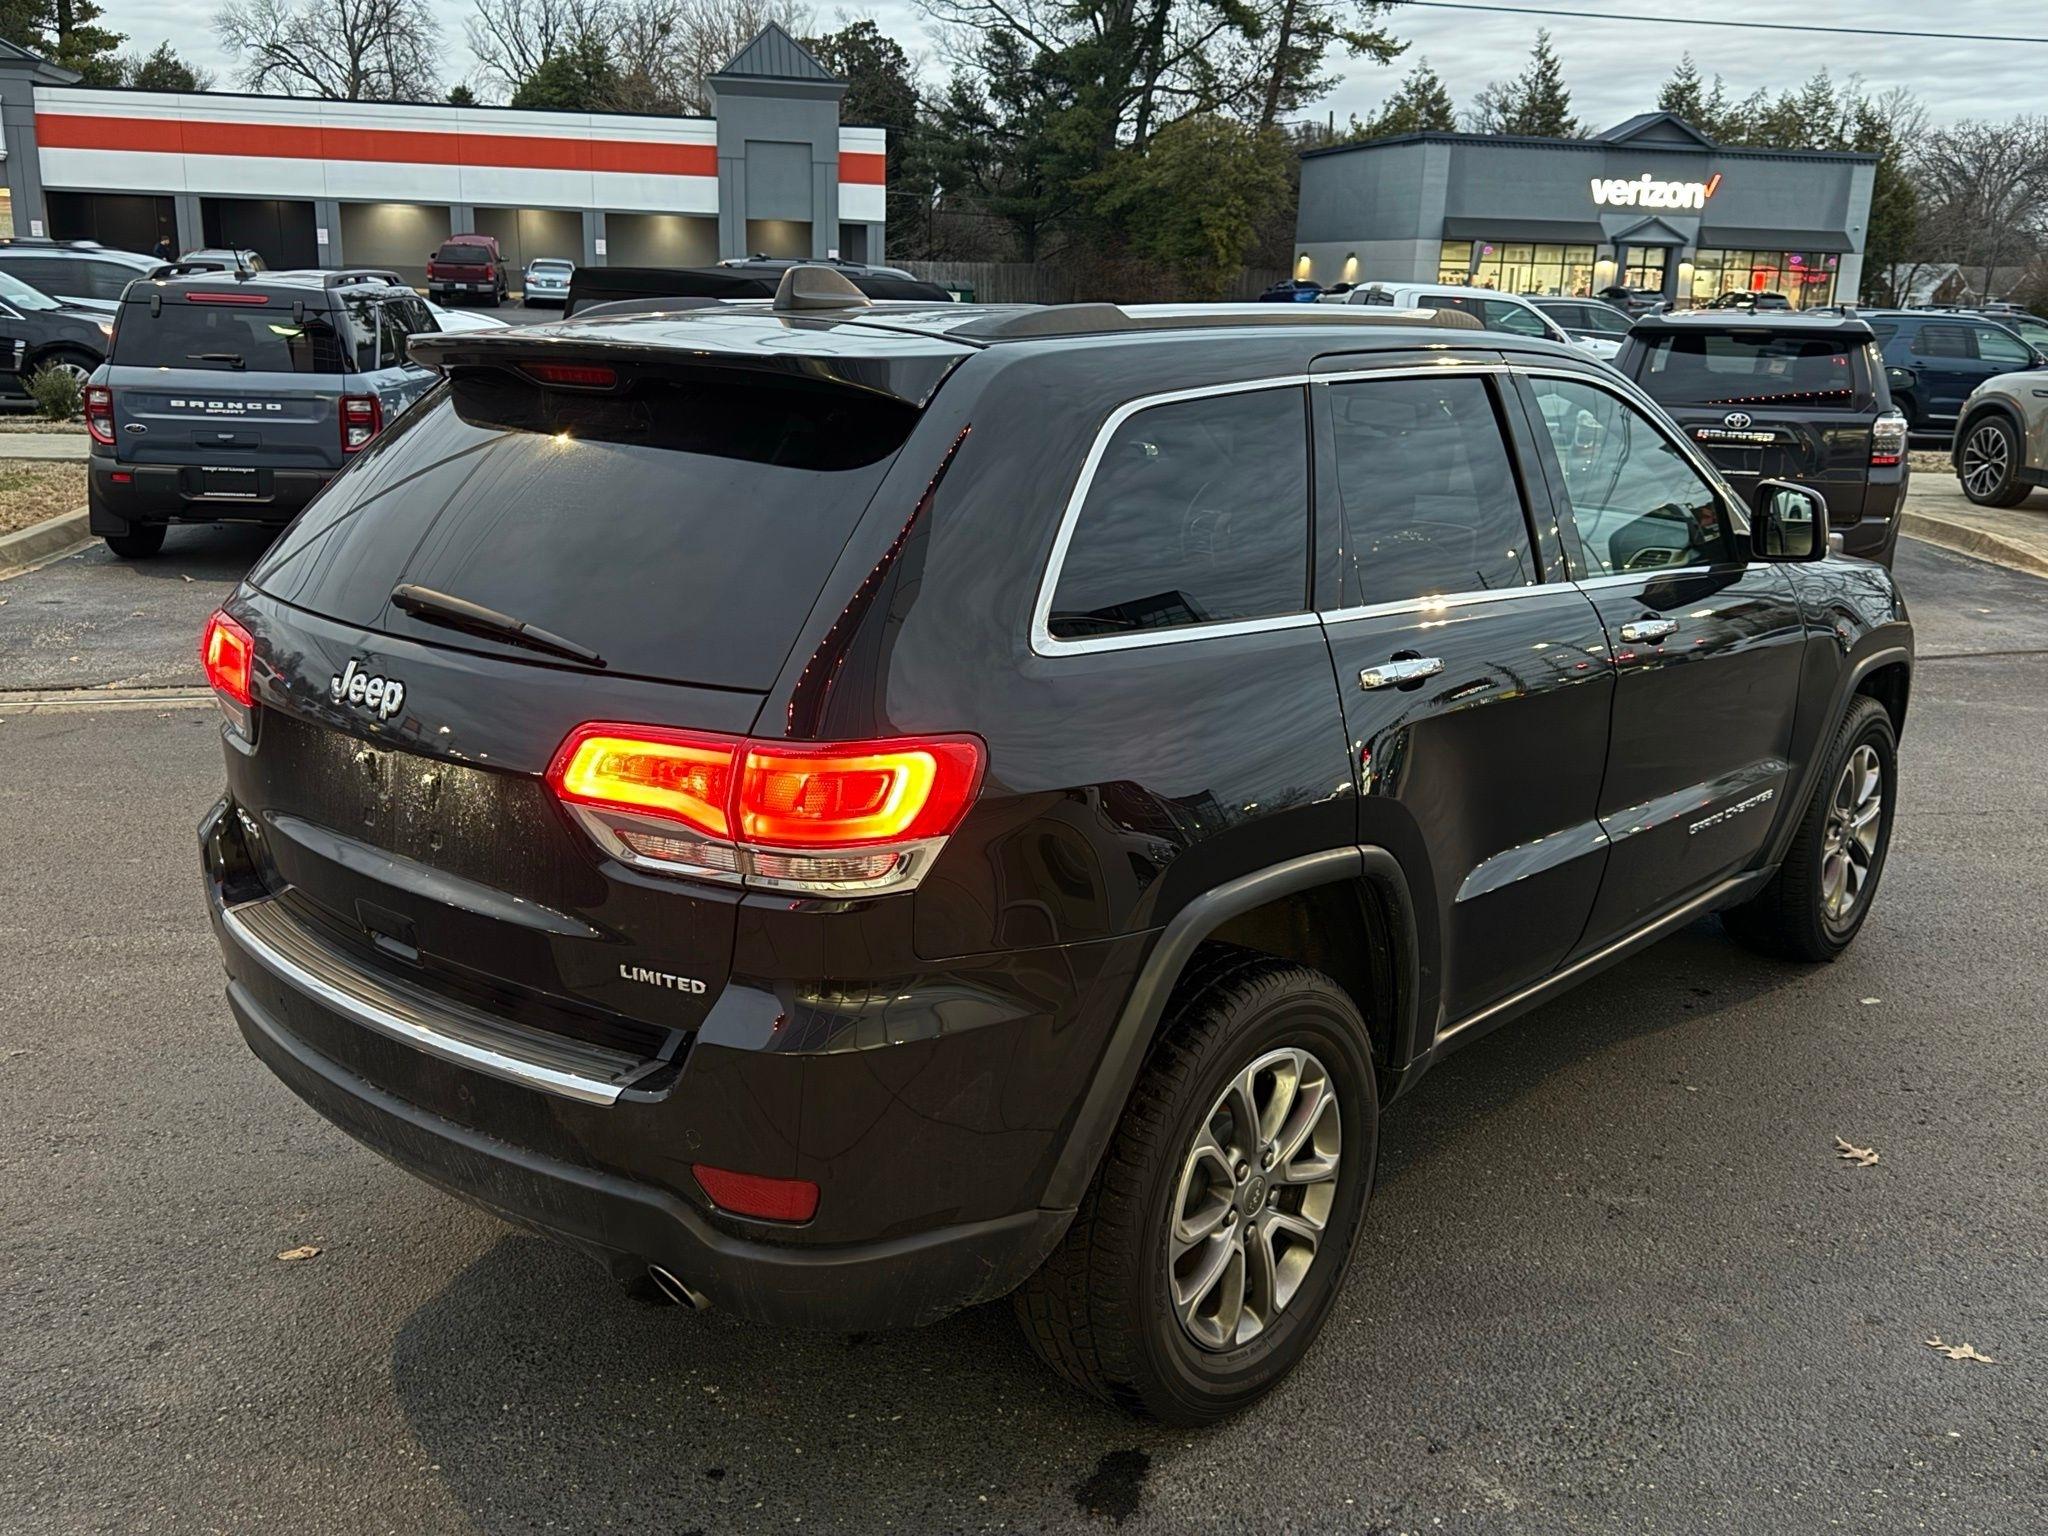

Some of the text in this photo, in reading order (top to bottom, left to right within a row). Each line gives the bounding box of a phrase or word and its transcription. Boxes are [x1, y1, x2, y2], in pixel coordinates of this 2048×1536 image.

[1591, 173, 1705, 209] verizon
[170, 400, 282, 411] BRONCO
[330, 659, 405, 721] Jeep
[619, 964, 707, 994] LIMITED
